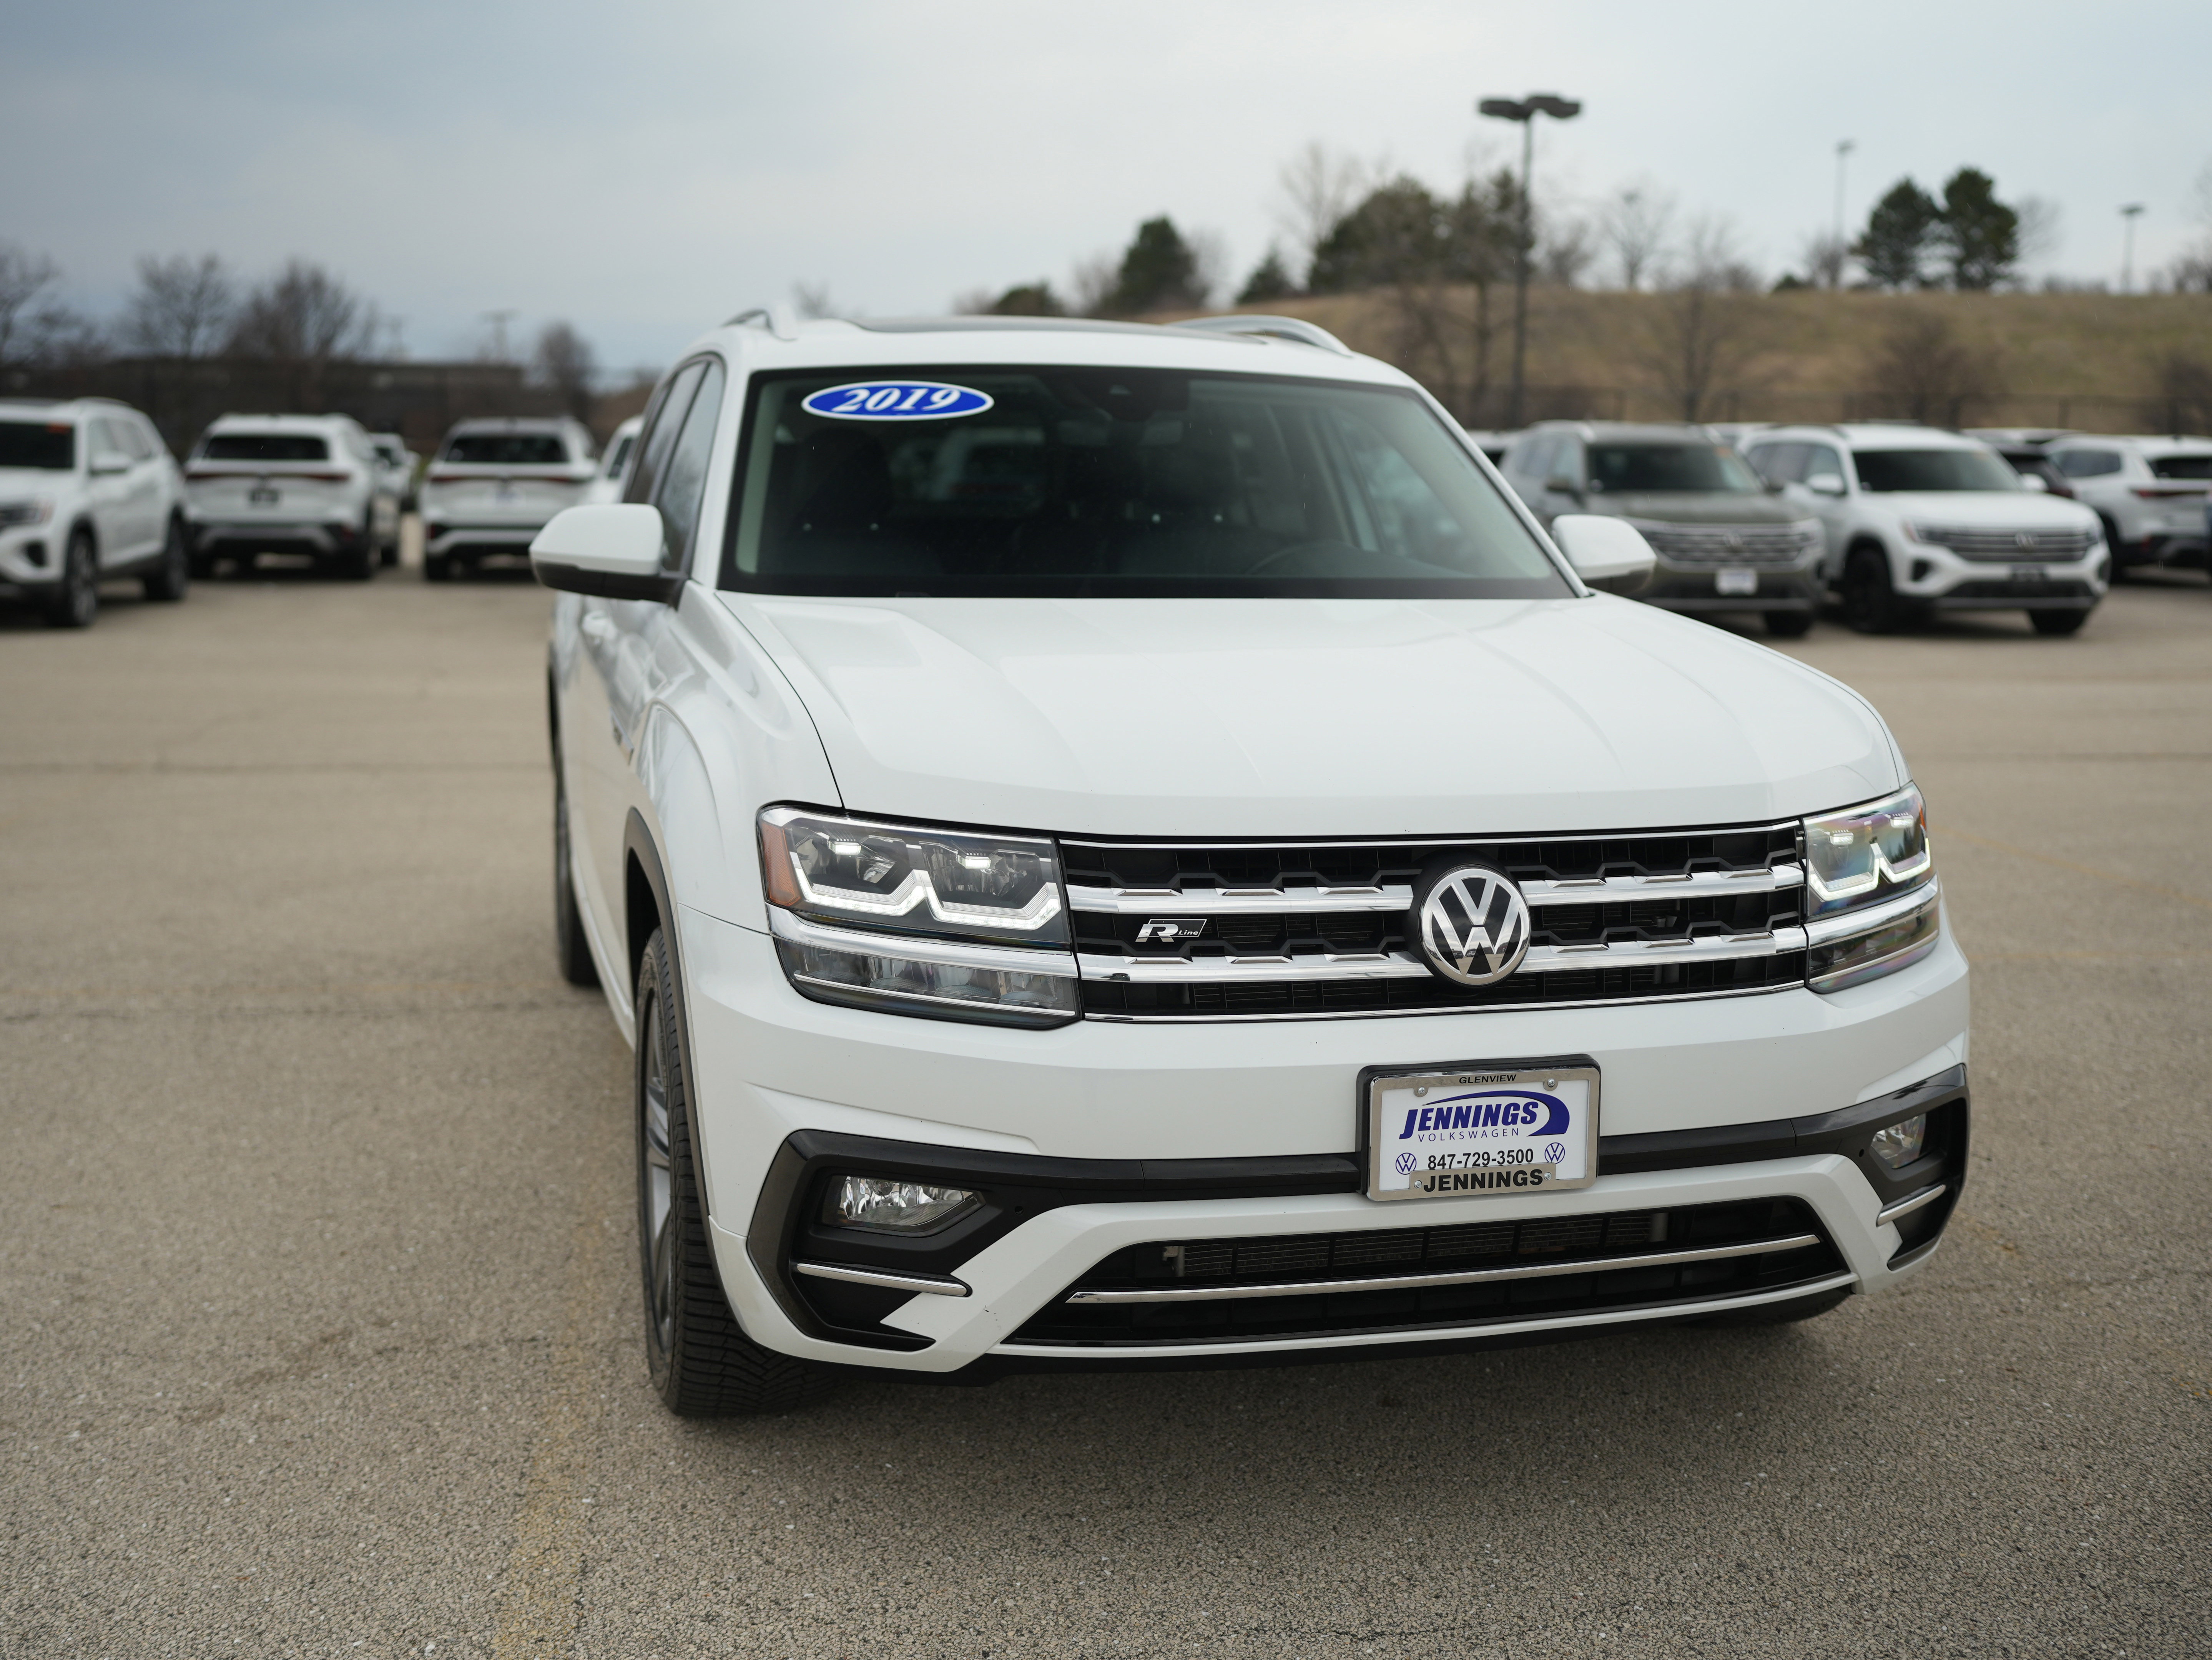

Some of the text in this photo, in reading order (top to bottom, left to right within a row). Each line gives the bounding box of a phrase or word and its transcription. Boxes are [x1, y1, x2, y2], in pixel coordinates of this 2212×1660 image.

[831, 387, 961, 412] 2019
[1135, 923, 1178, 942] R
[1459, 1074, 1517, 1084] GLENVIEW
[1399, 1101, 1539, 1139] JENNINGS
[1418, 1128, 1519, 1142] VOLKSWAGEN
[1428, 1148, 1534, 1170] 847-729-3500
[1423, 1169, 1543, 1192] JENNINGS
